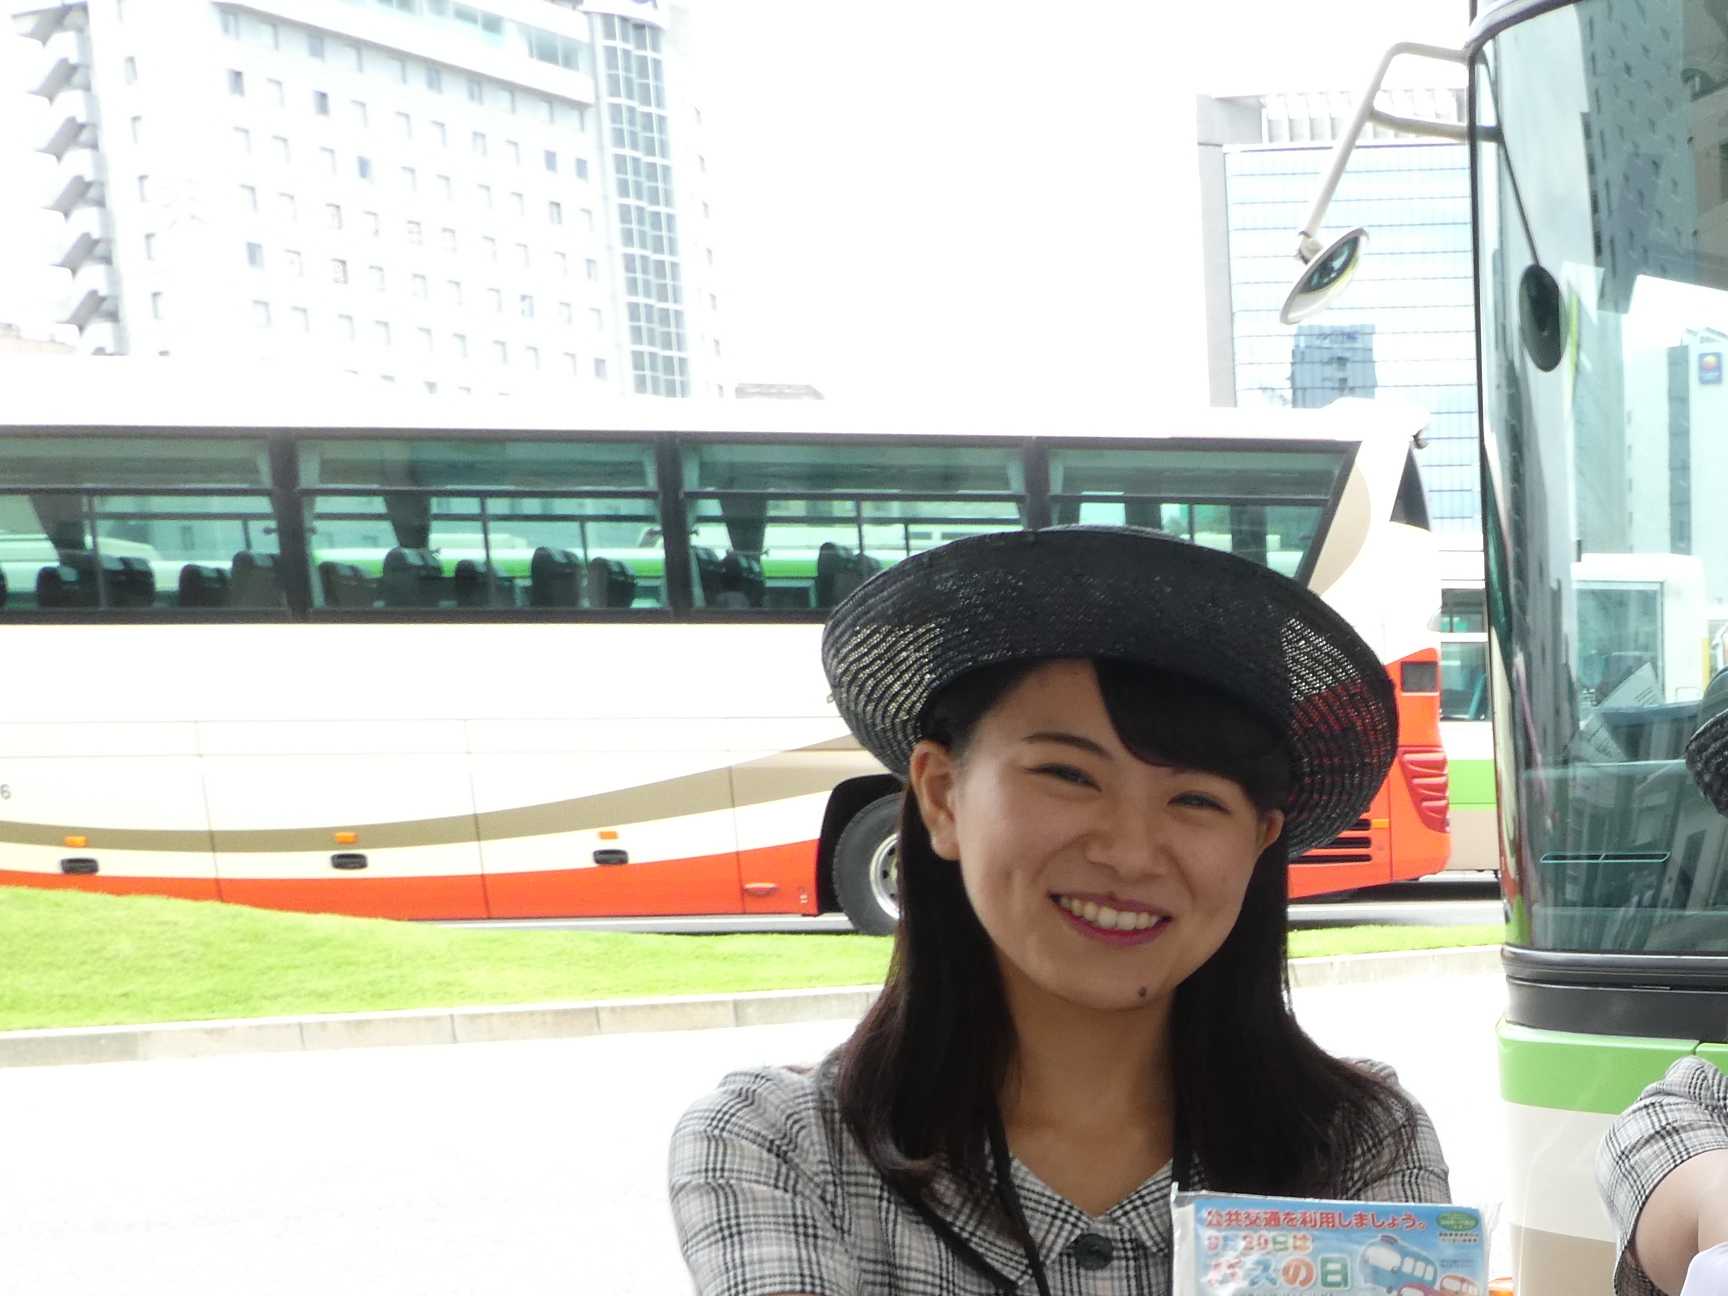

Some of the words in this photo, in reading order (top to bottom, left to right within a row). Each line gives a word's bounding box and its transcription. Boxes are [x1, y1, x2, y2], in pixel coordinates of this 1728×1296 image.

[1205, 1208, 1427, 1230] 公共交通を利用しましょう。
